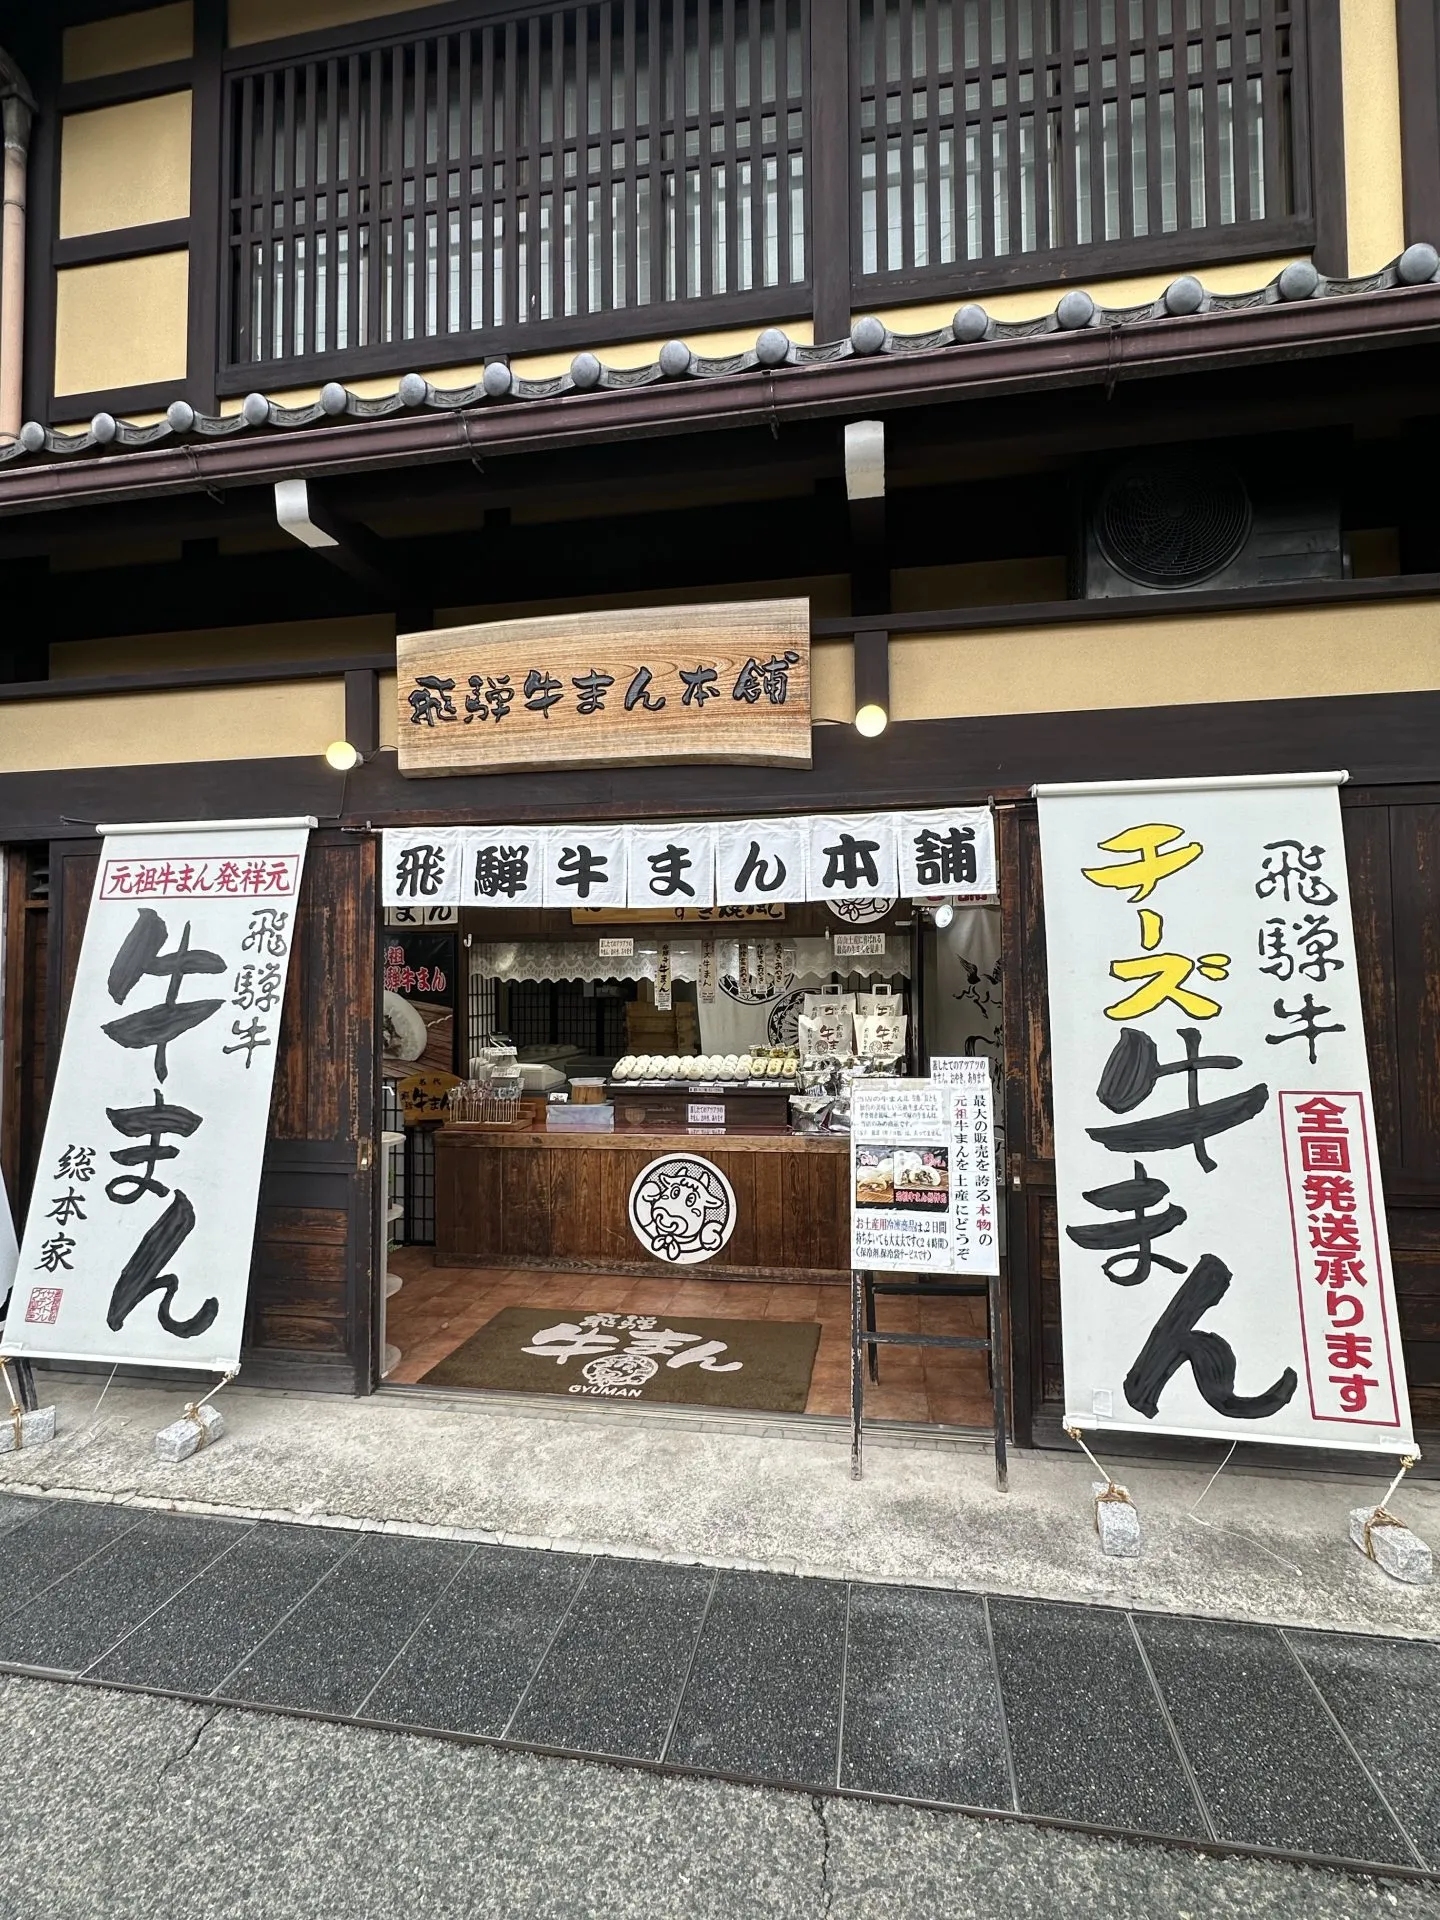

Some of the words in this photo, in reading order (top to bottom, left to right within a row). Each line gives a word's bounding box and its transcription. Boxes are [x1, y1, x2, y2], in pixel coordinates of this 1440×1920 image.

[109, 862, 289, 896] 元祖牛まん発祥元
[396, 827, 977, 899] 飛騨牛まん本舗
[223, 908, 288, 1069] 飛騨牛
[383, 945, 405, 965] 祖
[383, 966, 447, 993] 騨牛まん
[1256, 843, 1345, 1065] 飛騨牛
[101, 908, 228, 1338] 牛まん
[34, 1144, 97, 1272] 総本家
[954, 1095, 970, 1261] 元祖牛まんを土産にどうぞ
[1295, 1097, 1379, 1412] 全国発送承ります
[520, 1322, 744, 1372] 牛まん
[568, 1384, 643, 1399] GYUMAN
